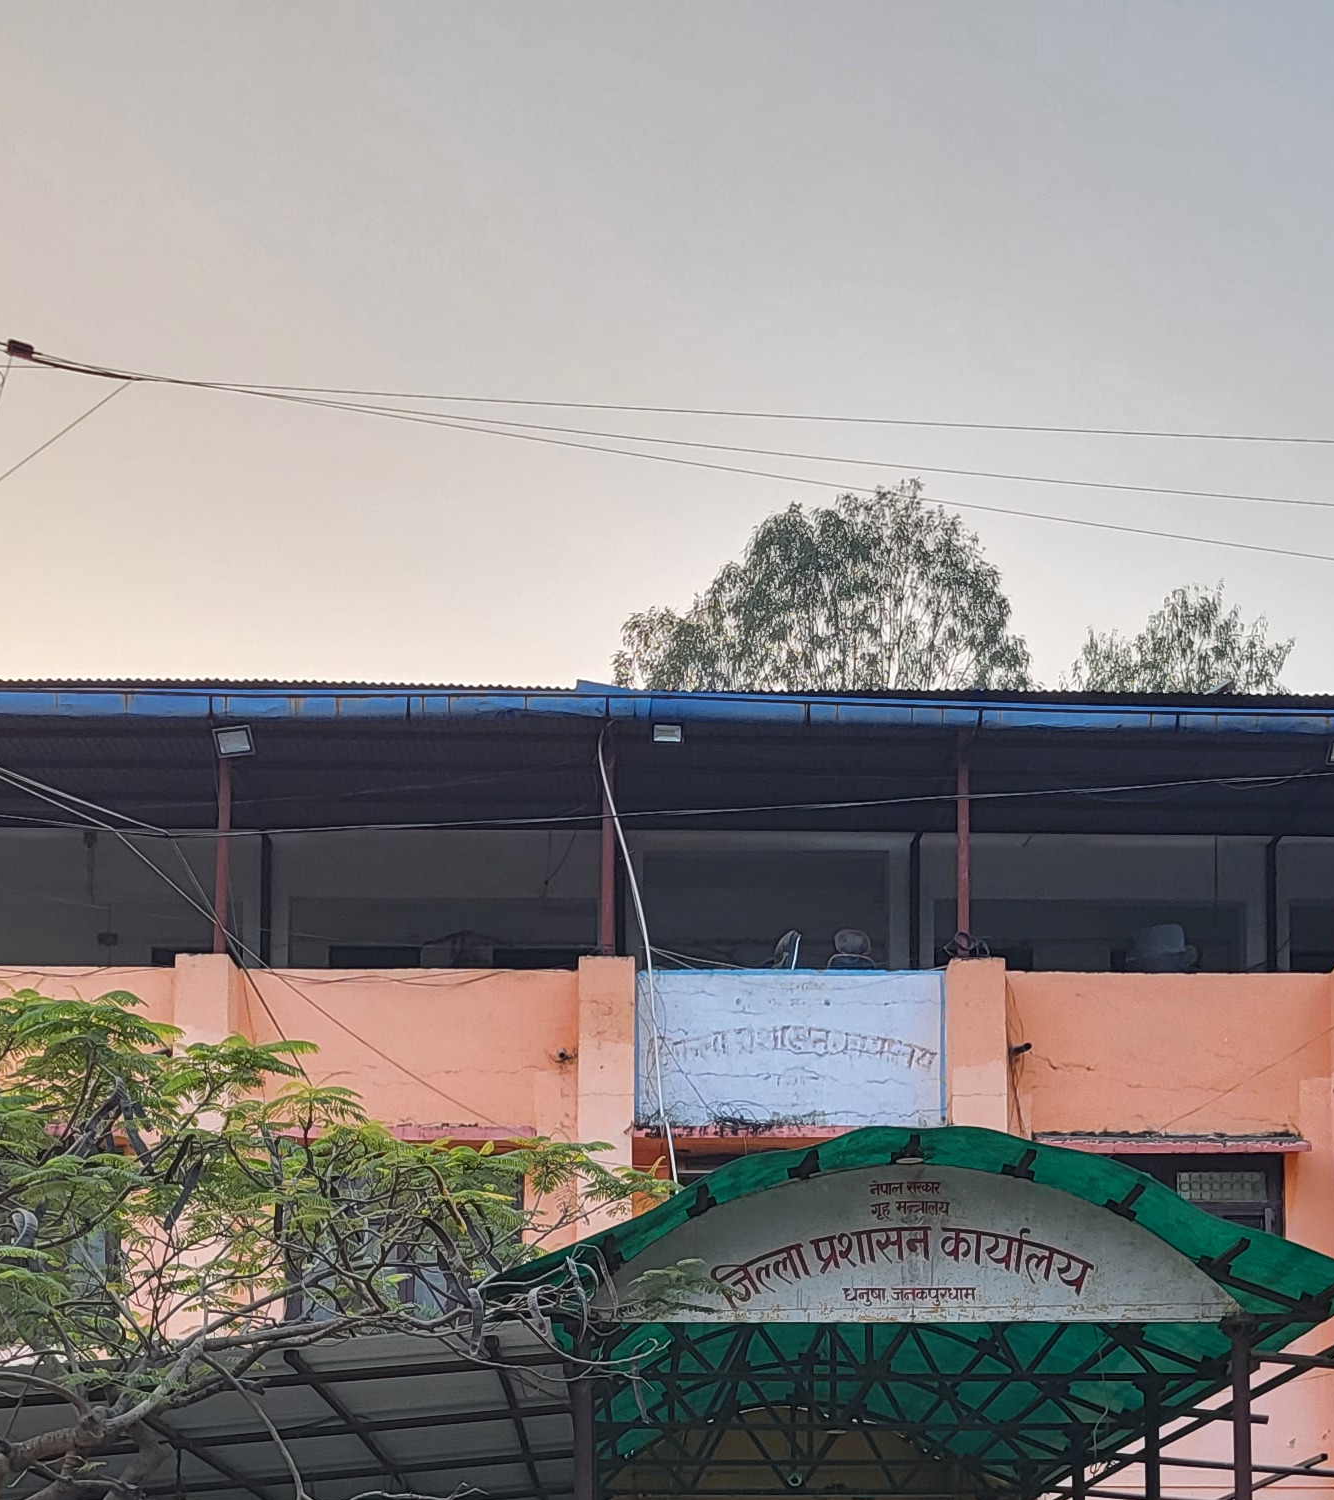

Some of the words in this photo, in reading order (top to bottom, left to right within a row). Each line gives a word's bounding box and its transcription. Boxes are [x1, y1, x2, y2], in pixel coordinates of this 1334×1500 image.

[870, 1180, 904, 1195] नेपाल
[907, 1182, 940, 1194] सरकार
[870, 1201, 890, 1220] गृह
[896, 1201, 950, 1216] मन्त्रालय
[710, 1242, 811, 1310] जिल्ला
[808, 1226, 931, 1274] प्रशासन
[940, 1227, 1094, 1296] कार्यालय
[891, 1287, 977, 1305] जनकपुरधाम
